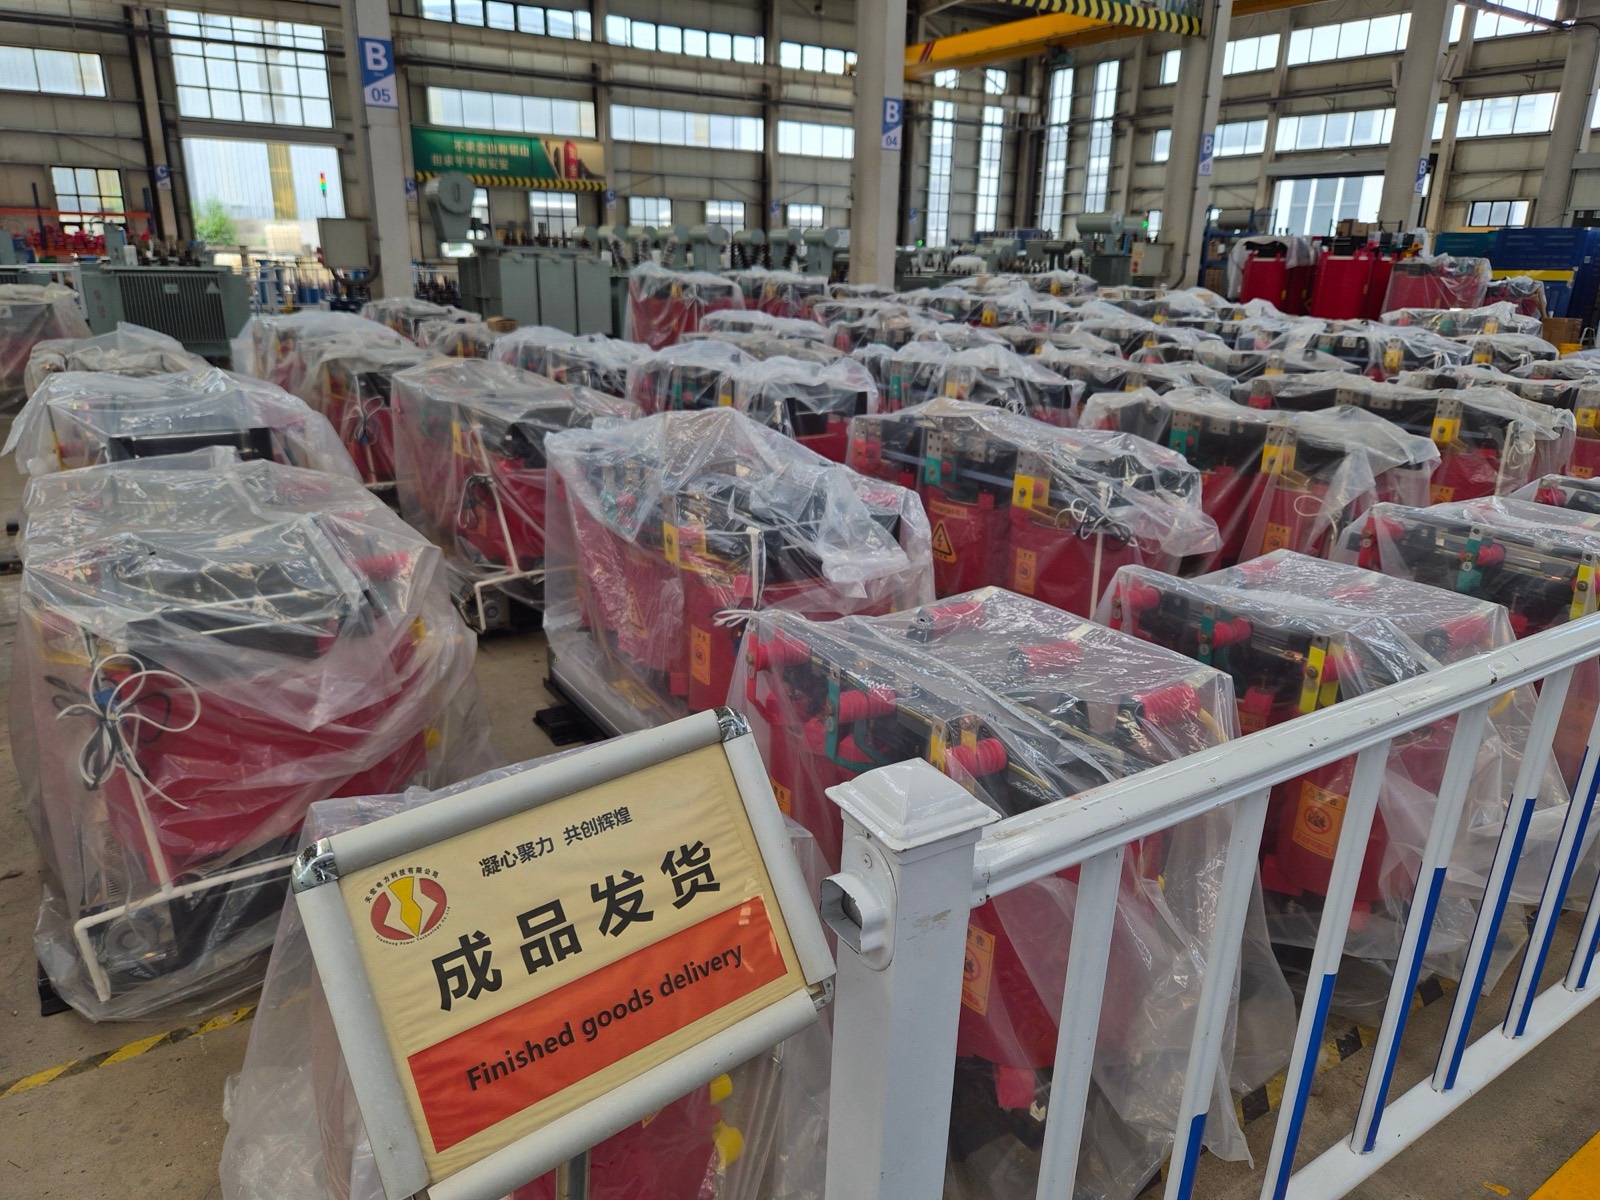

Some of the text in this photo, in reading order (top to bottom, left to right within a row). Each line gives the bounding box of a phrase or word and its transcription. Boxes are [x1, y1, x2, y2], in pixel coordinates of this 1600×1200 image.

[364, 40, 389, 72] B
[371, 87, 391, 103] 05
[885, 100, 900, 123] B
[885, 135, 898, 147] 04
[1203, 136, 1213, 154] B
[1419, 160, 1427, 175] B
[479, 806, 633, 877] 凝心聚力 共创辉煌
[431, 840, 721, 1012] 成品发货
[466, 945, 742, 1092] Finished goods delivery
